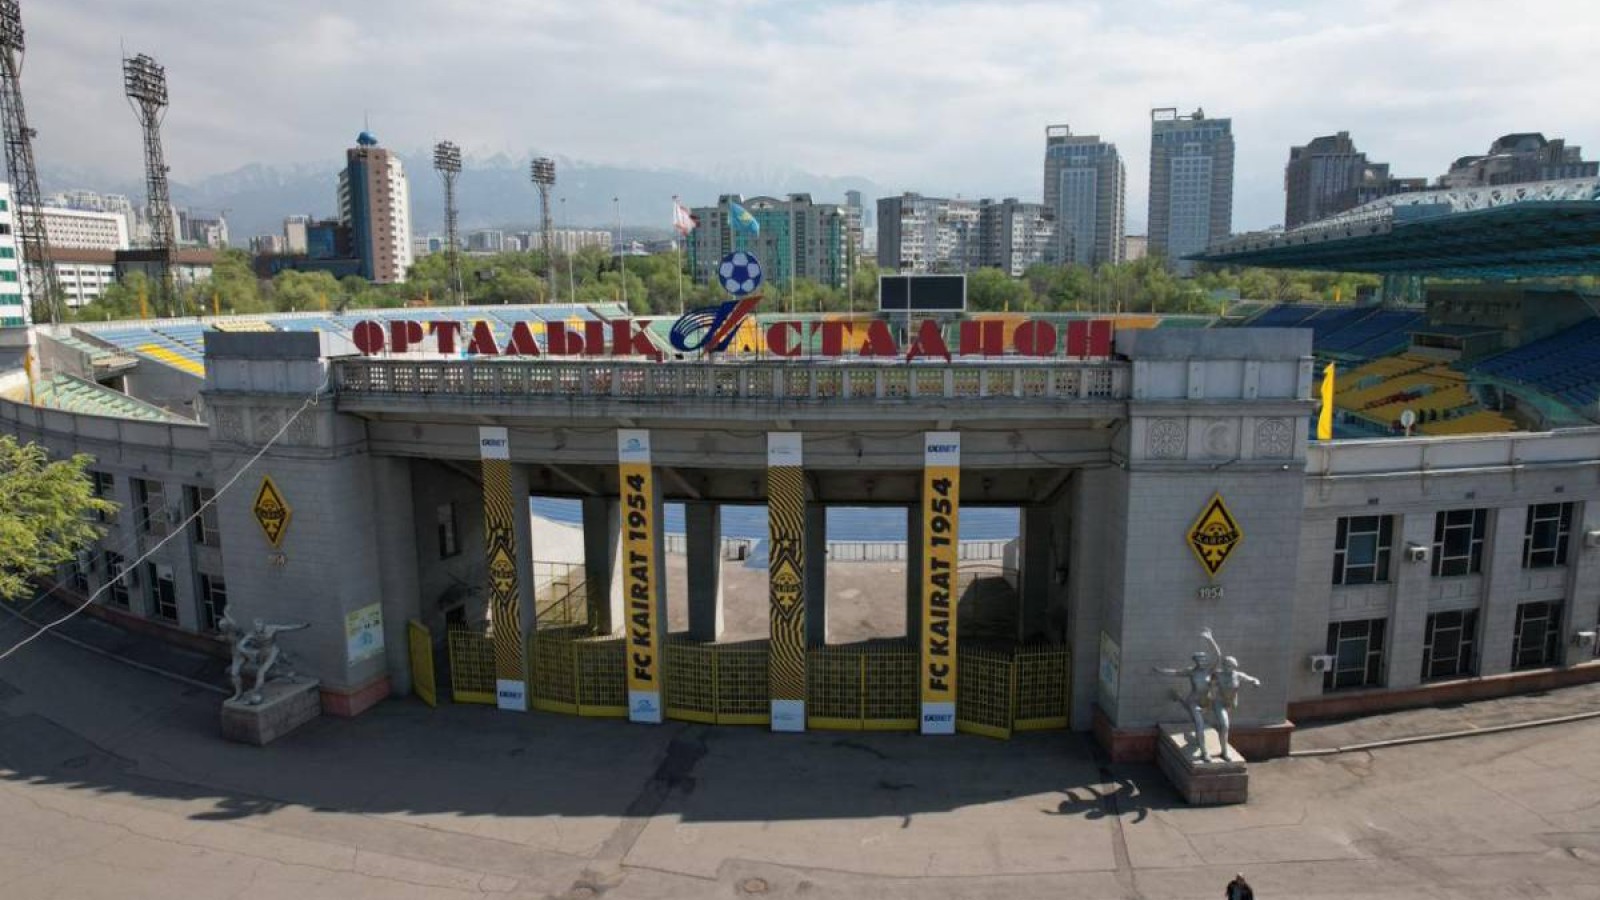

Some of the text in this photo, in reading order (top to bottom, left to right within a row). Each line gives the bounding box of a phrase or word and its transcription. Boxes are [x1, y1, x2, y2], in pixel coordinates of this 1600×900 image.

[626, 473, 647, 541] 1954
[629, 551, 651, 648] KAIRAT
[928, 477, 953, 692] FC KAIRAT 1954
[634, 653, 653, 681] FC
